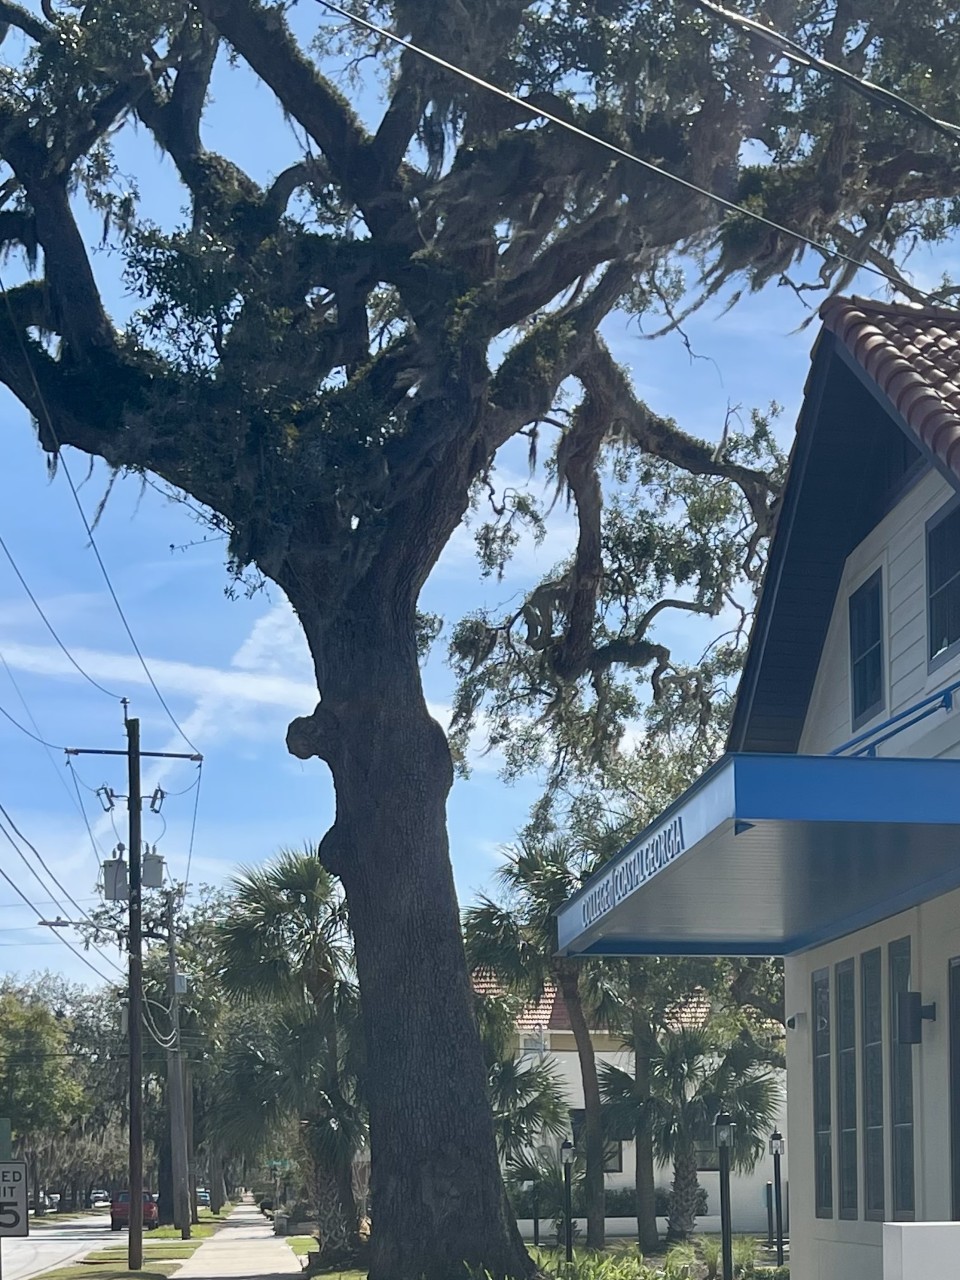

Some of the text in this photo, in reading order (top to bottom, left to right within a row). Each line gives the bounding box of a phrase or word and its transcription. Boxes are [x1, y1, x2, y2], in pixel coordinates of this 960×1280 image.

[614, 849, 646, 901] COASTAL
[645, 816, 685, 876] GEORGIA
[0, 1202, 20, 1228] 5
